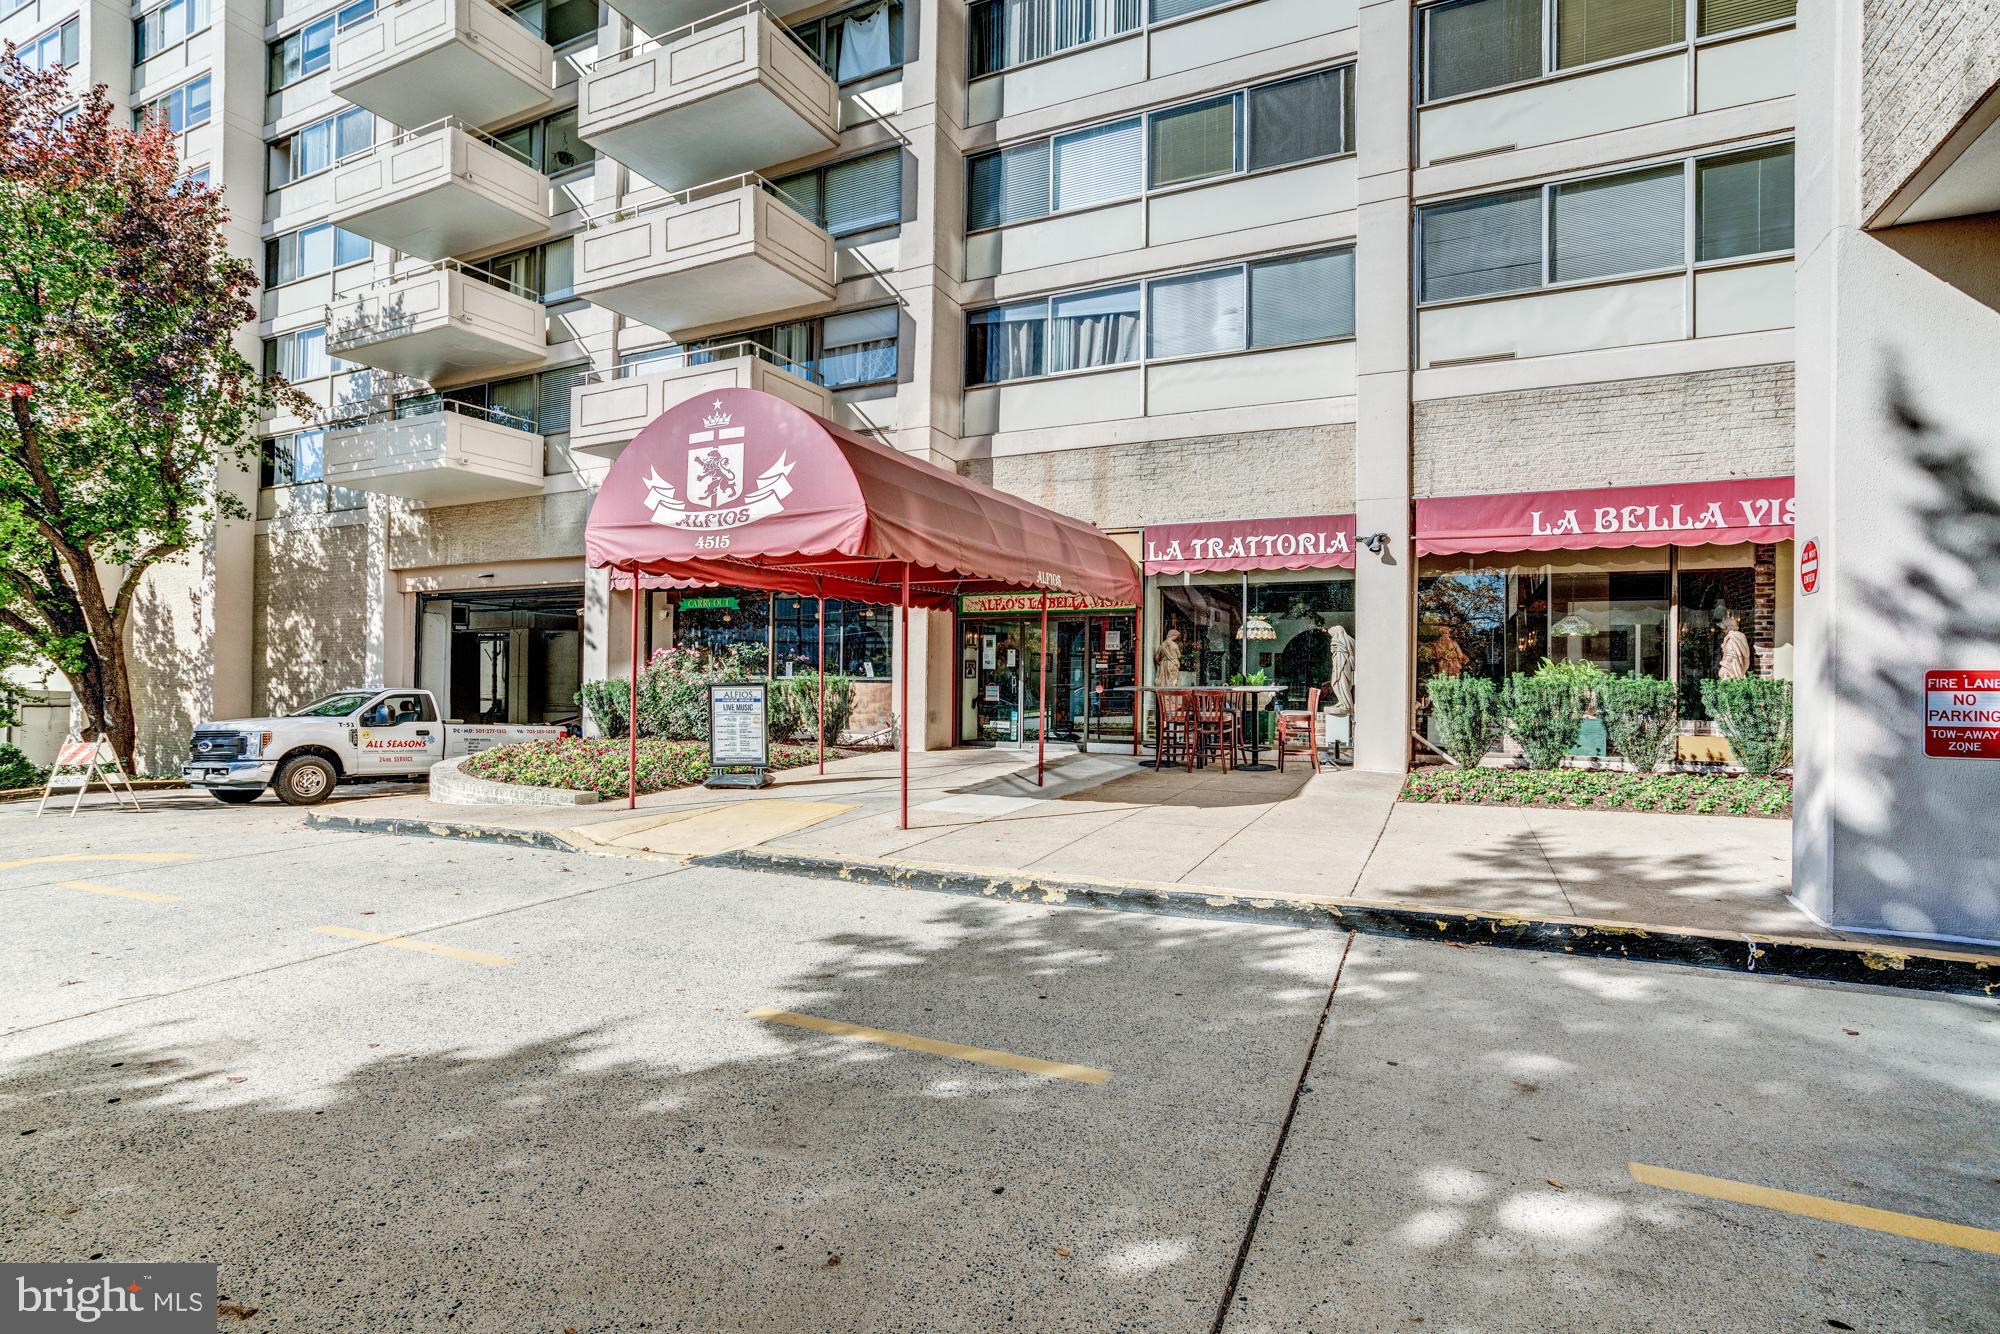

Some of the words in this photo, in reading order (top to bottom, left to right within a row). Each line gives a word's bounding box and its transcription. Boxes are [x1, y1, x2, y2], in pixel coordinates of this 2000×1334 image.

[675, 507, 751, 529] ALFIOS
[1530, 509, 1582, 536] LA
[1594, 502, 1728, 534] BELLA
[694, 535, 730, 550] 4515
[1147, 540, 1184, 561] LA
[1190, 531, 1351, 560] TRATTORIA
[1036, 570, 1062, 587] ALFIOS
[688, 598, 729, 609] CARRY-OUT
[1047, 596, 1089, 610] BELLA
[1928, 678, 1958, 689] FIRE
[1964, 678, 2000, 689] LANE
[1953, 694, 1977, 706] NO
[723, 704, 735, 712] LIVE
[736, 704, 754, 712] MUSIC
[1928, 709, 2000, 722] PARKING
[1931, 729, 1999, 740] TOW-AWAY
[365, 740, 383, 749] ALL
[386, 739, 427, 748] SEASONS
[1948, 742, 1982, 752] ZONE
